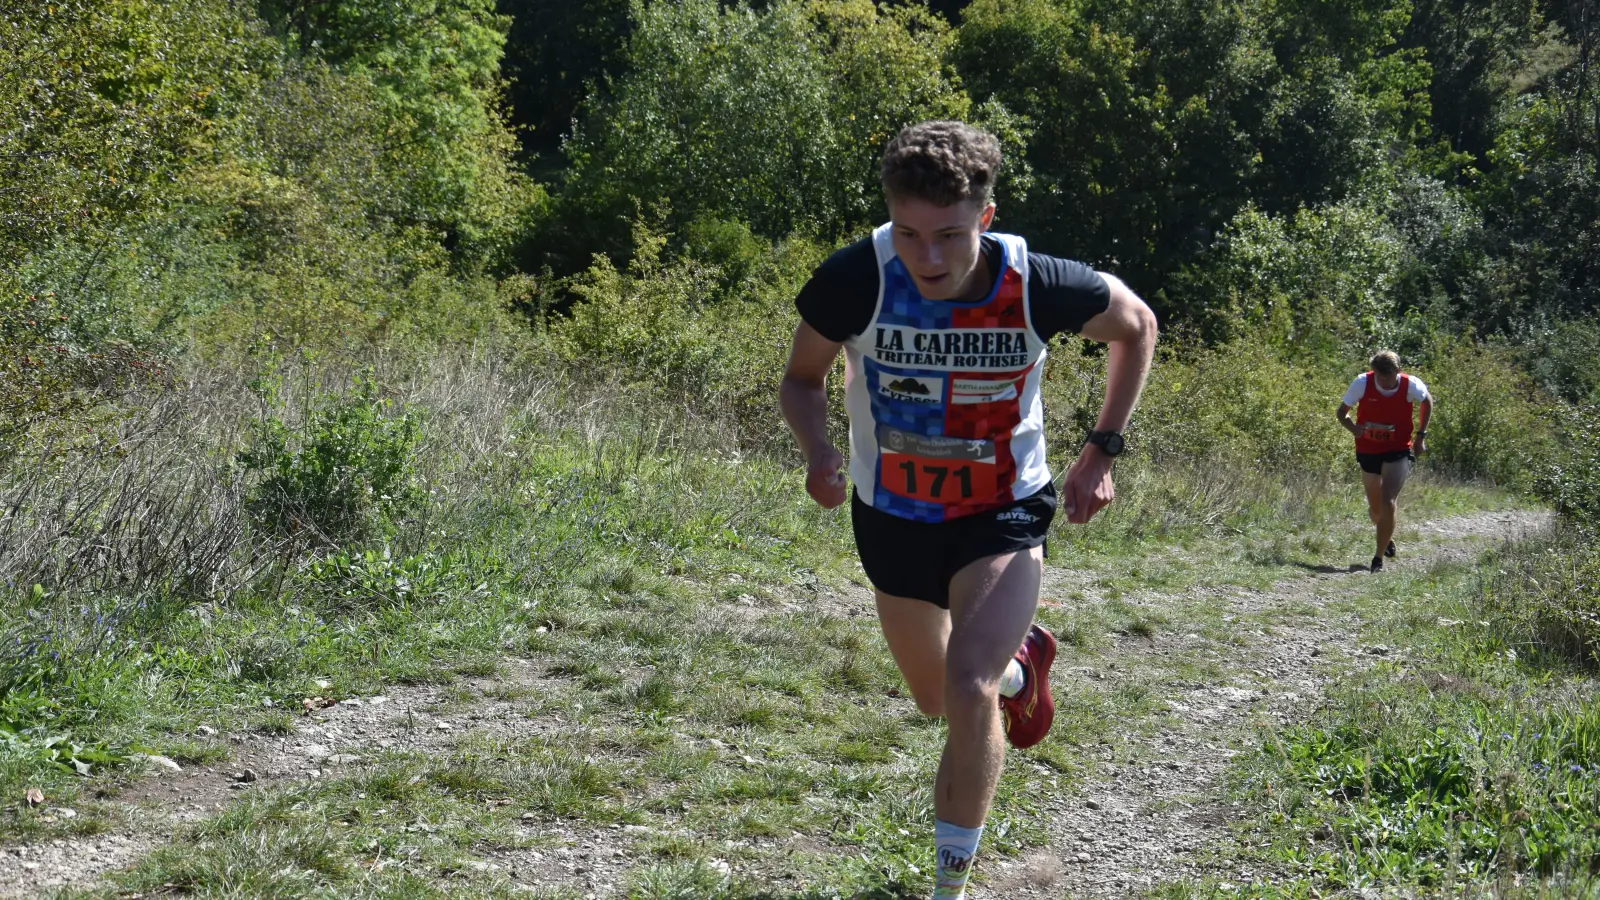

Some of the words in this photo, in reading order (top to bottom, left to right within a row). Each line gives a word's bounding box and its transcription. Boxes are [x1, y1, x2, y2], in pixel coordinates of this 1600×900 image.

[875, 327, 904, 351] LA
[913, 332, 1028, 355] CARRERA
[875, 349, 948, 366] TRITEAM
[953, 354, 1028, 368] ROTHSEE
[1369, 430, 1390, 440] 169
[899, 460, 973, 498] 171
[996, 511, 1040, 522] SAYSKY
